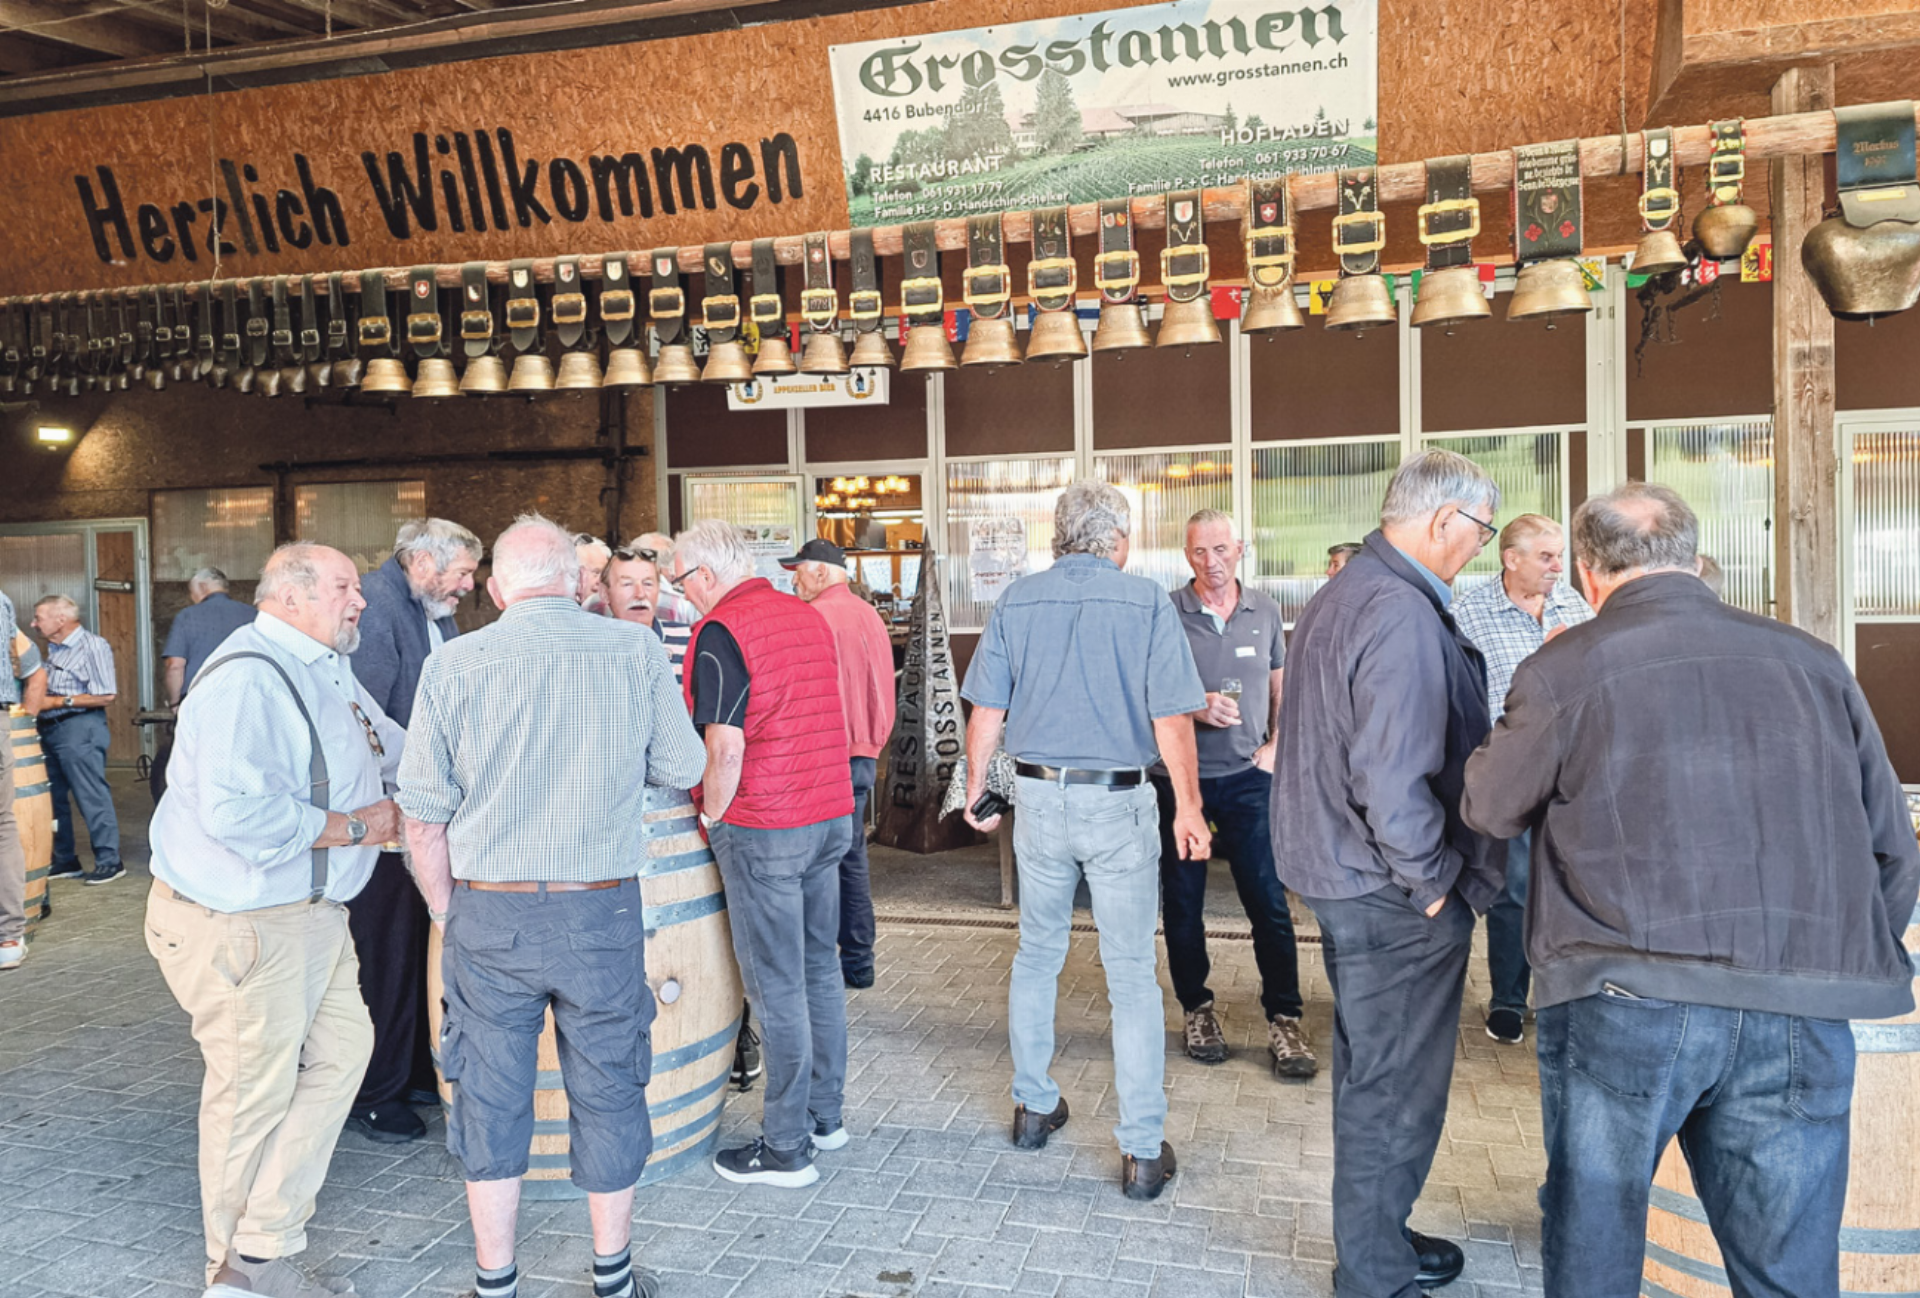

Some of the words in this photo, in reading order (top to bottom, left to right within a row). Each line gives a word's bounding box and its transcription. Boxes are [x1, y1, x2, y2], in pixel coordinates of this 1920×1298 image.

[858, 3, 1350, 98] Grosstannen
[1167, 53, 1349, 89] www.grosstannen.ch
[863, 104, 900, 123] 4416
[905, 99, 988, 119] Bubendorf
[1221, 118, 1350, 147] HOFLADEN
[870, 155, 1003, 184] RESTAURANT
[1200, 156, 1244, 171] Telefon
[1255, 152, 1279, 165] 061
[1283, 148, 1308, 162] 933
[1311, 145, 1328, 159] 70
[1331, 143, 1350, 157] 67
[75, 153, 350, 264] Herzlich
[361, 127, 804, 239] Willkommen
[873, 190, 913, 204] Telefon
[922, 186, 943, 199] 061
[946, 184, 968, 198] 931
[973, 183, 985, 196] 17
[989, 181, 1004, 194] 79
[1128, 179, 1171, 194] Familie
[1174, 175, 1186, 189] P.
[874, 206, 914, 219] Familie
[916, 202, 928, 215] H.
[893, 614, 924, 810] RESTAURANT
[930, 611, 960, 806] ROSSTANNEN
